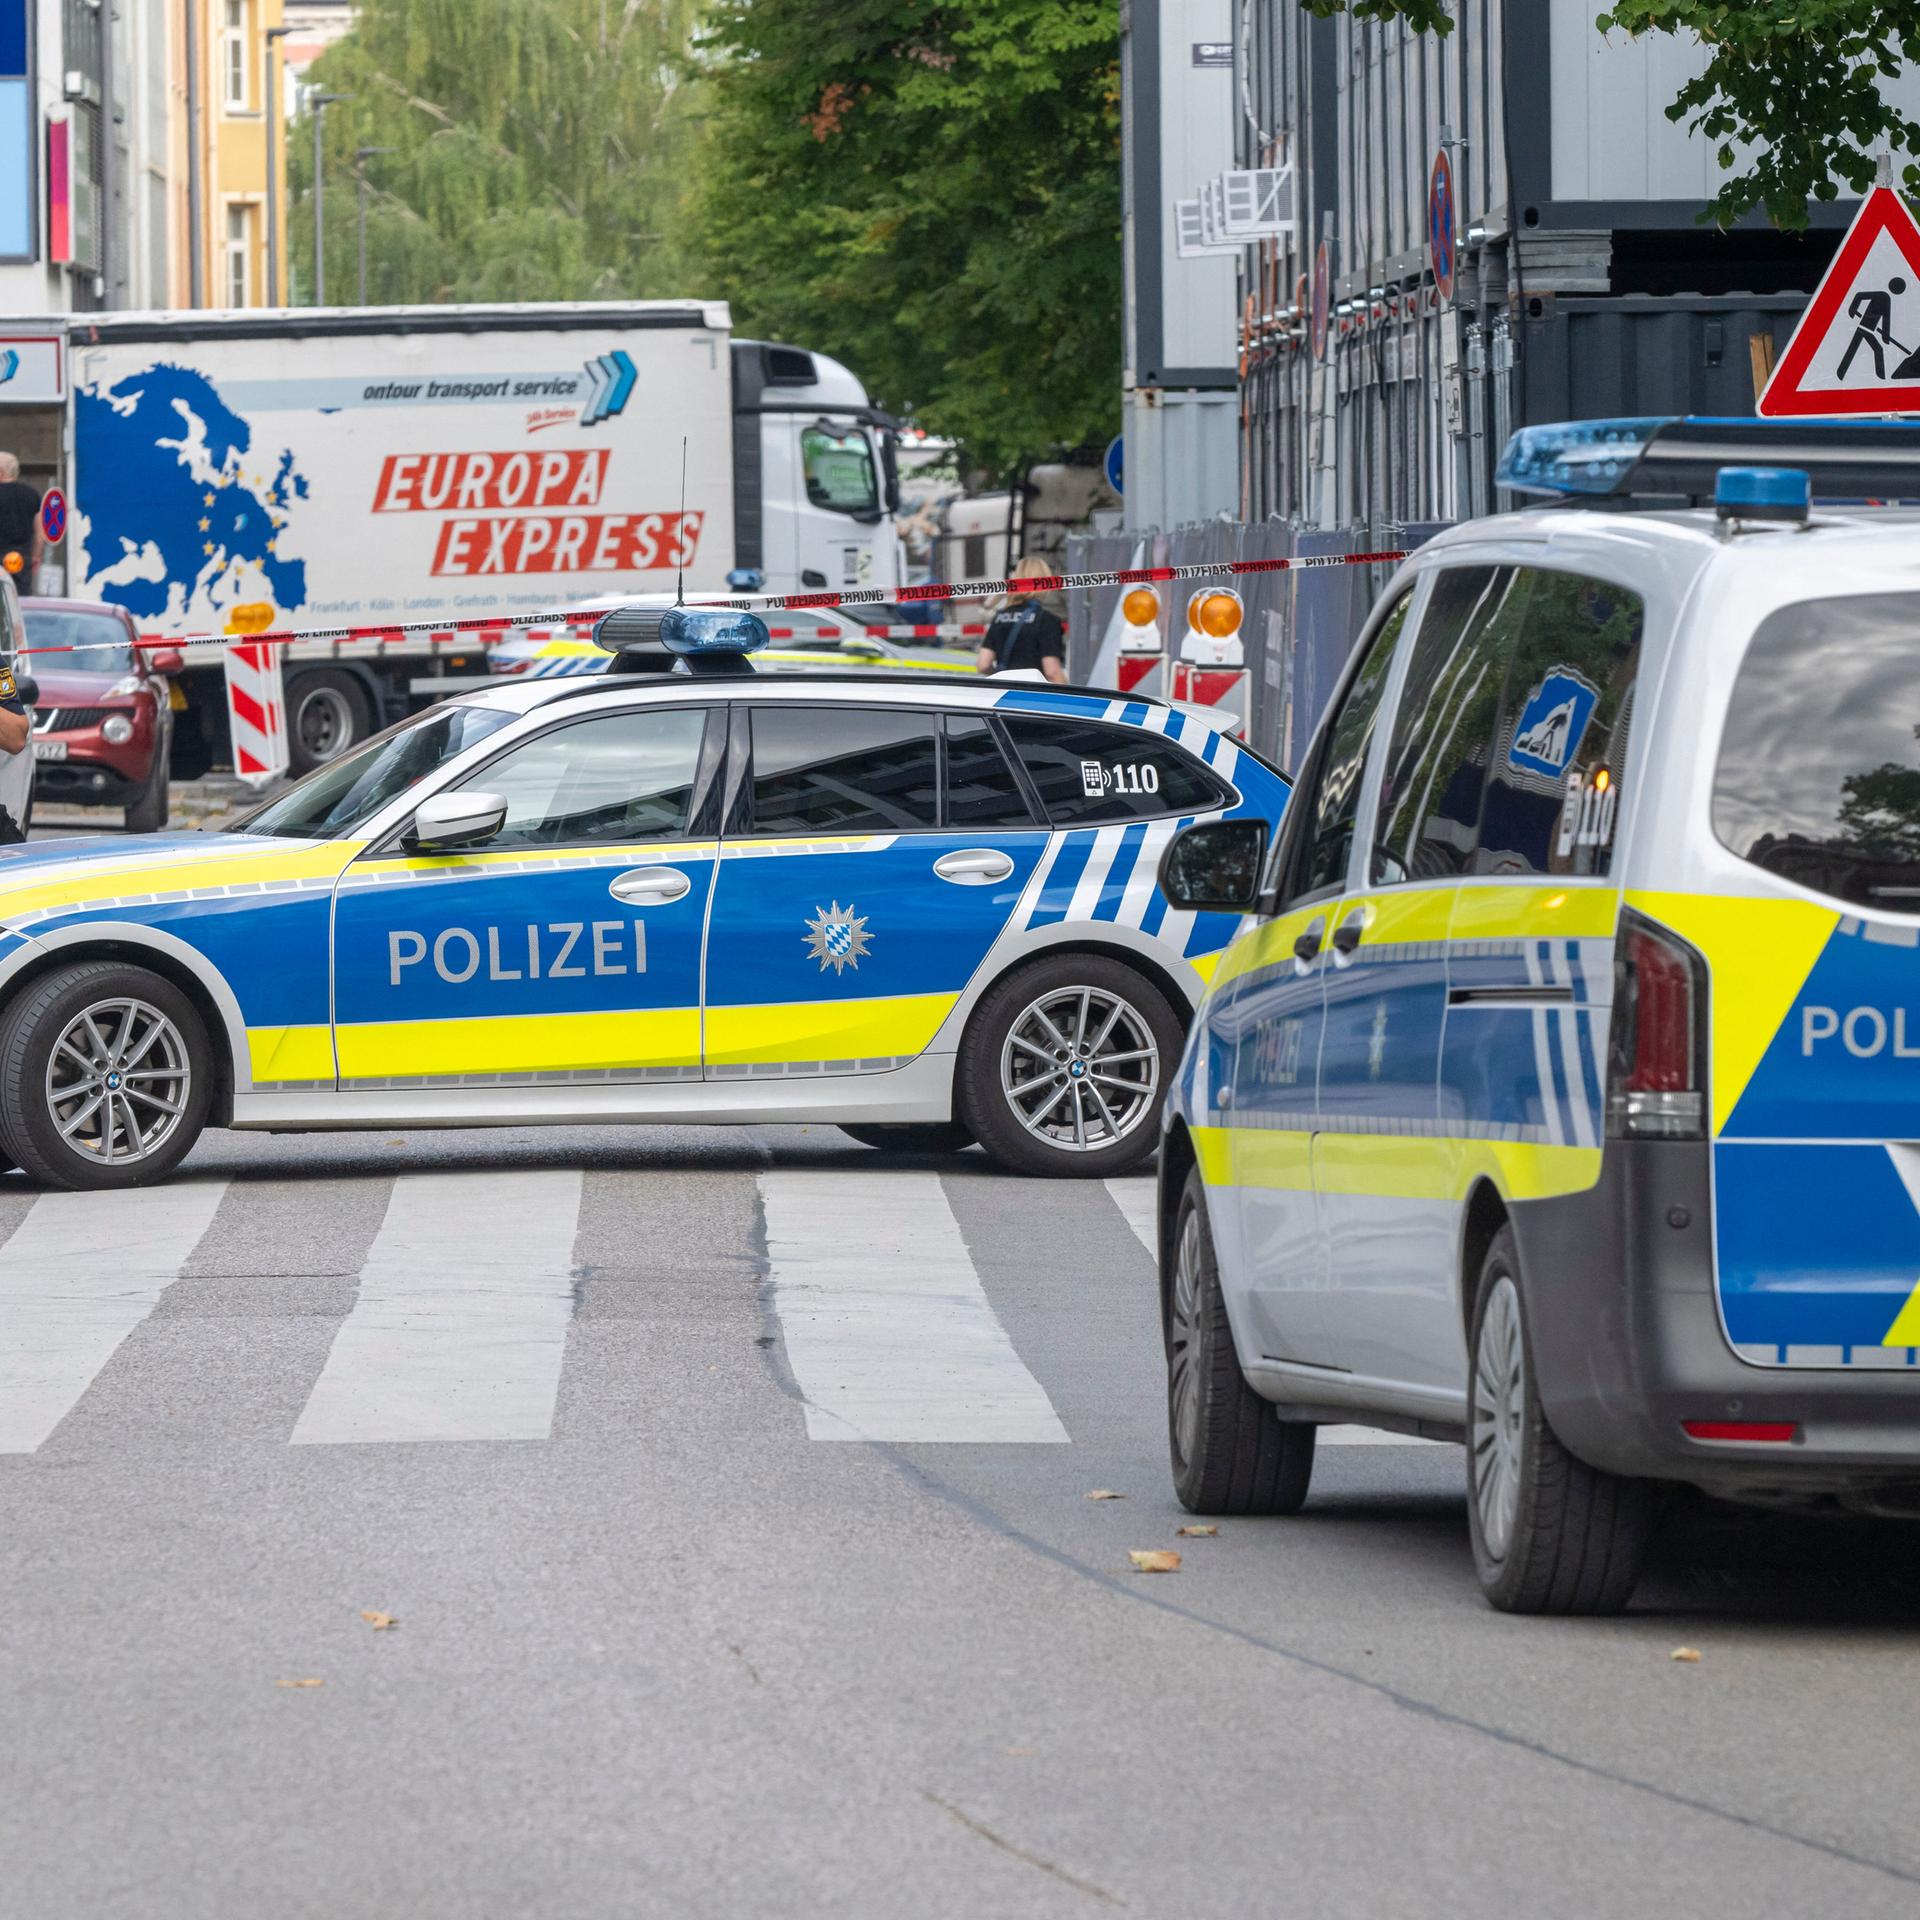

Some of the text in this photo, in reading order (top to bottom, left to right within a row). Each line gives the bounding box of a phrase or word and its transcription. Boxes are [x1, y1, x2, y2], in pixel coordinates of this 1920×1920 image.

[364, 377, 578, 400] ontour transport service
[380, 450, 601, 510] EUROPA
[440, 513, 701, 575] EXPRESS
[900, 580, 1018, 600] POLIZEIABSPERRUNG
[1033, 570, 1153, 590] POLIZEIABSPERRUNG
[766, 589, 885, 608] POLIZEIABSPERRUNG
[1112, 763, 1159, 794] 110
[388, 919, 648, 986] POLIZEI
[1802, 1006, 1920, 1058] POL
